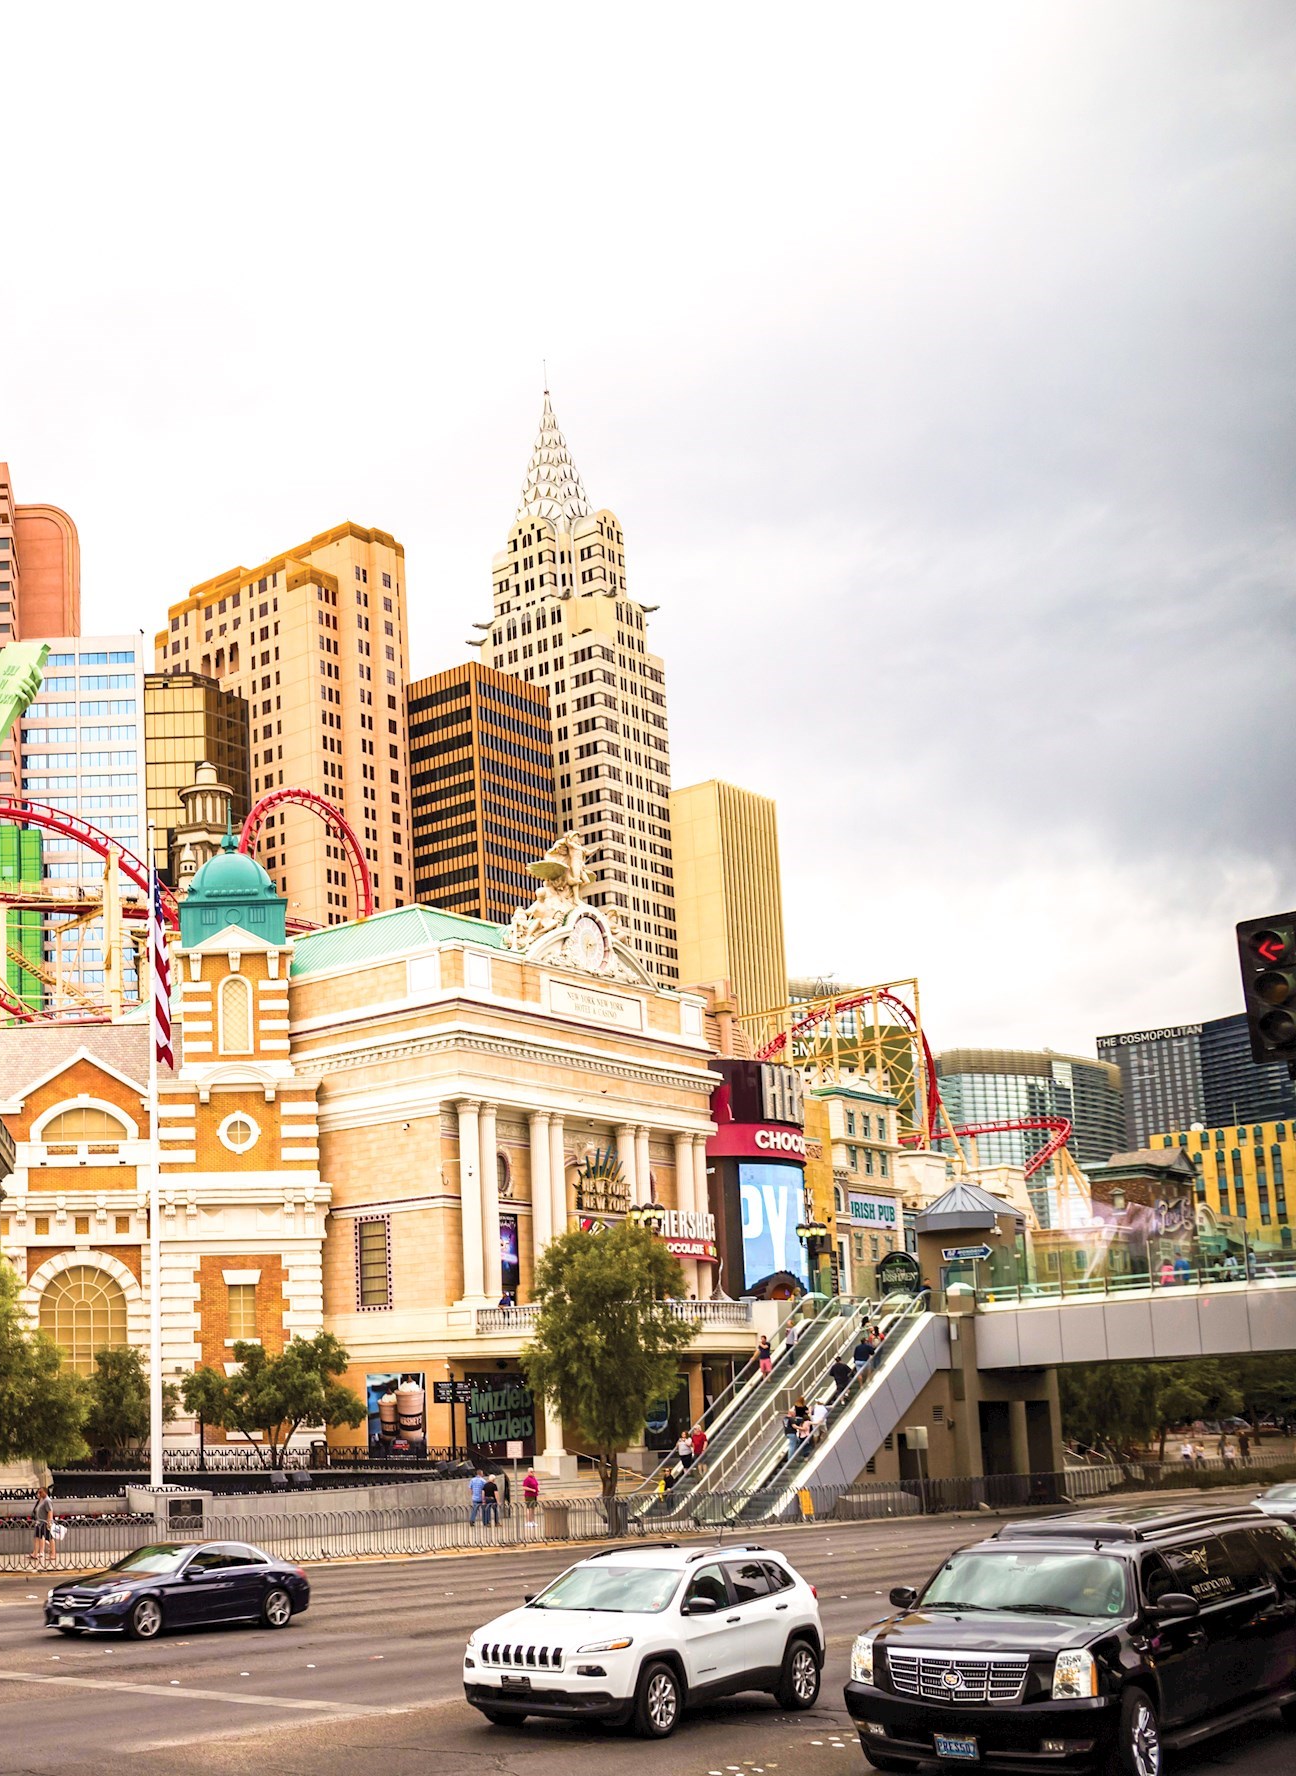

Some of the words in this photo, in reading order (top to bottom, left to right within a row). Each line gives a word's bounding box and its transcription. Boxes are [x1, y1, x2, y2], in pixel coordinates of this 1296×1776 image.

[566, 991, 579, 1001] NEW
[580, 994, 596, 1006] YORK
[596, 998, 609, 1008] NEW
[610, 1001, 624, 1012] YORK
[574, 1003, 591, 1014] HOTEL
[598, 1009, 618, 1019] CASINO
[1097, 1037, 1117, 1049] THE
[1119, 1024, 1203, 1045] COSMOPOLITAN
[790, 1041, 815, 1057] GM
[582, 1178, 606, 1194] NEW
[607, 1182, 632, 1198] YORK
[582, 1193, 606, 1211] NEW
[608, 1197, 631, 1212] YORK
[850, 1201, 876, 1220] IRISH
[877, 1204, 896, 1223] PUB
[665, 1242, 705, 1255] OCOLATE
[470, 1383, 532, 1415] Twizzlers
[466, 1410, 534, 1445] Twizzlers
